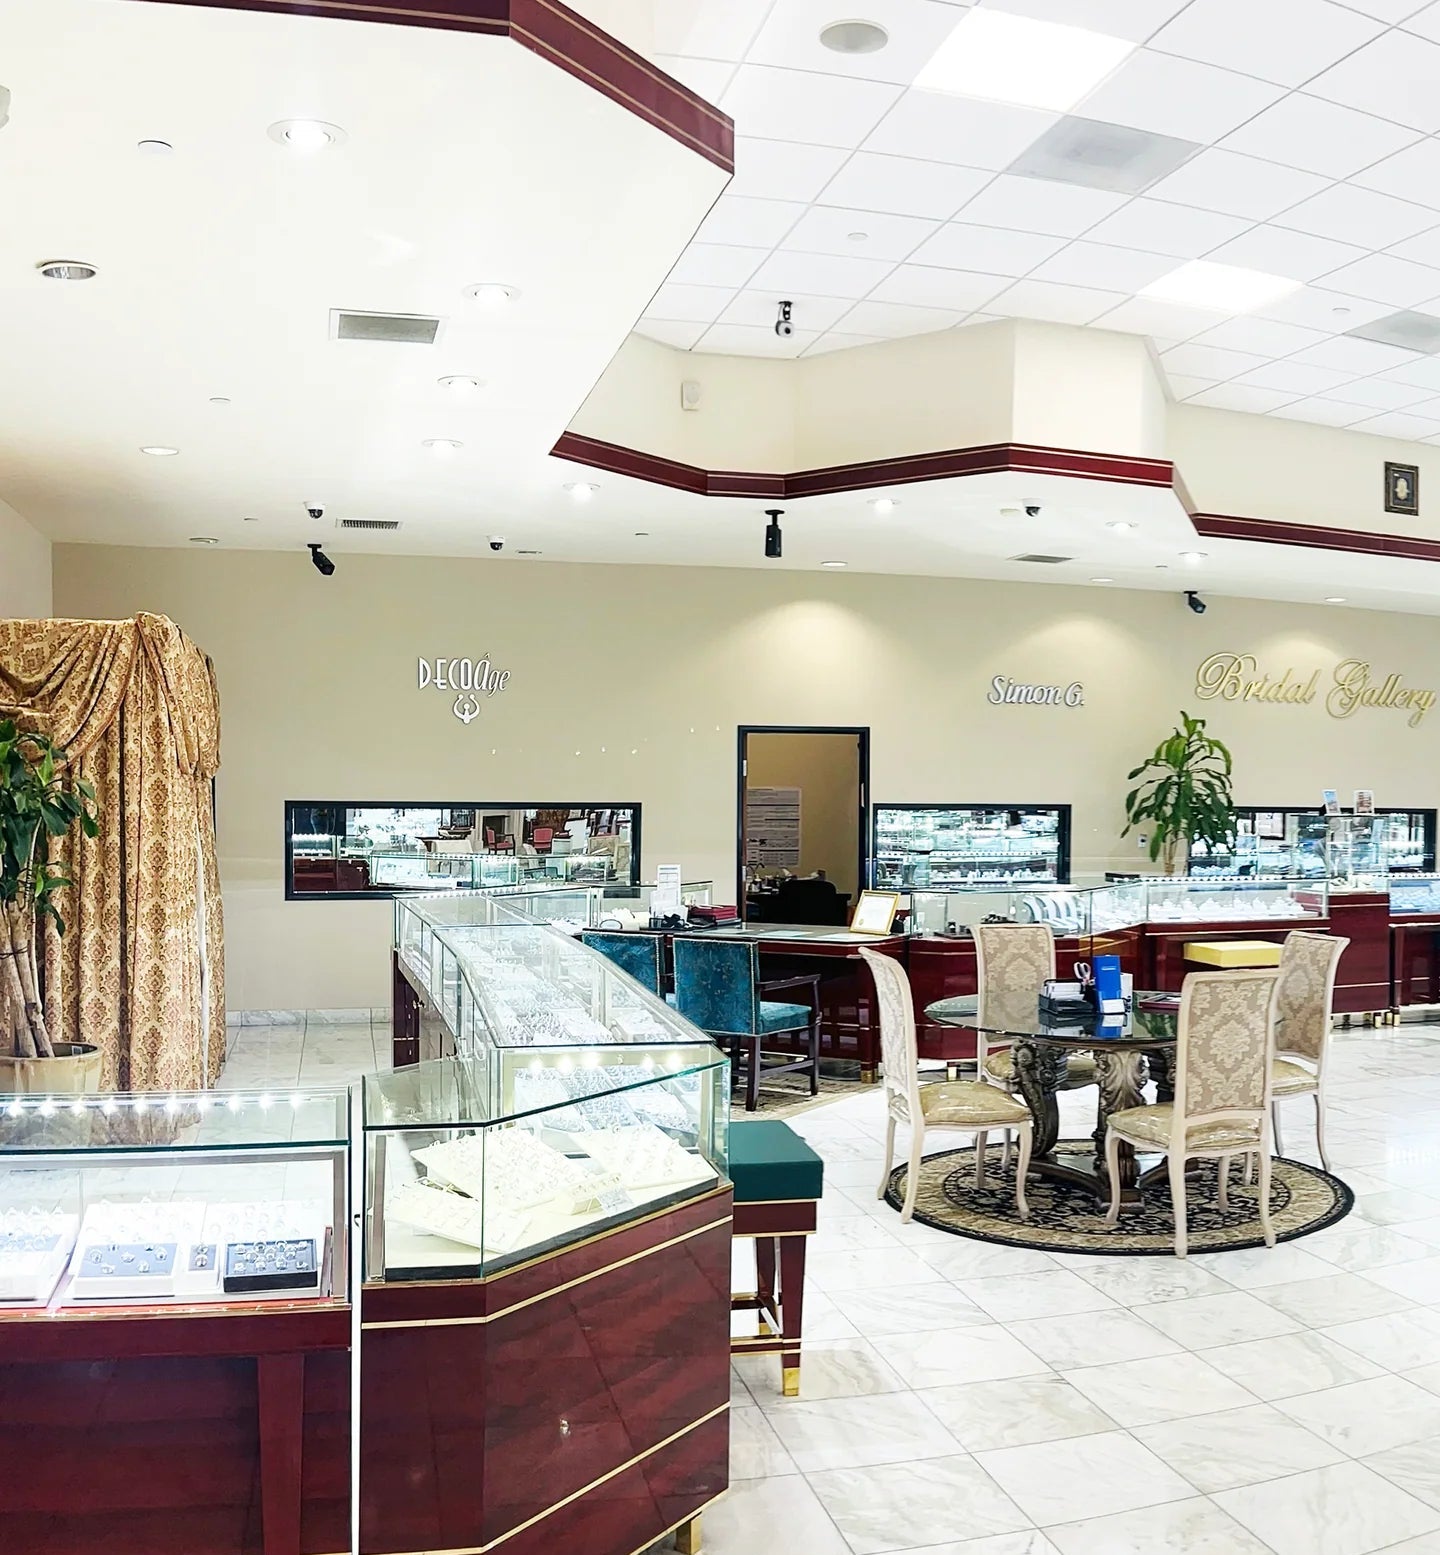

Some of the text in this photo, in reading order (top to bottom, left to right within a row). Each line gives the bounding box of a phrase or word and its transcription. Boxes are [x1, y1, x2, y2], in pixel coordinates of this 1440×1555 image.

[987, 675, 1085, 707] Simon G.
[1195, 652, 1437, 728] Bridal Gallery
